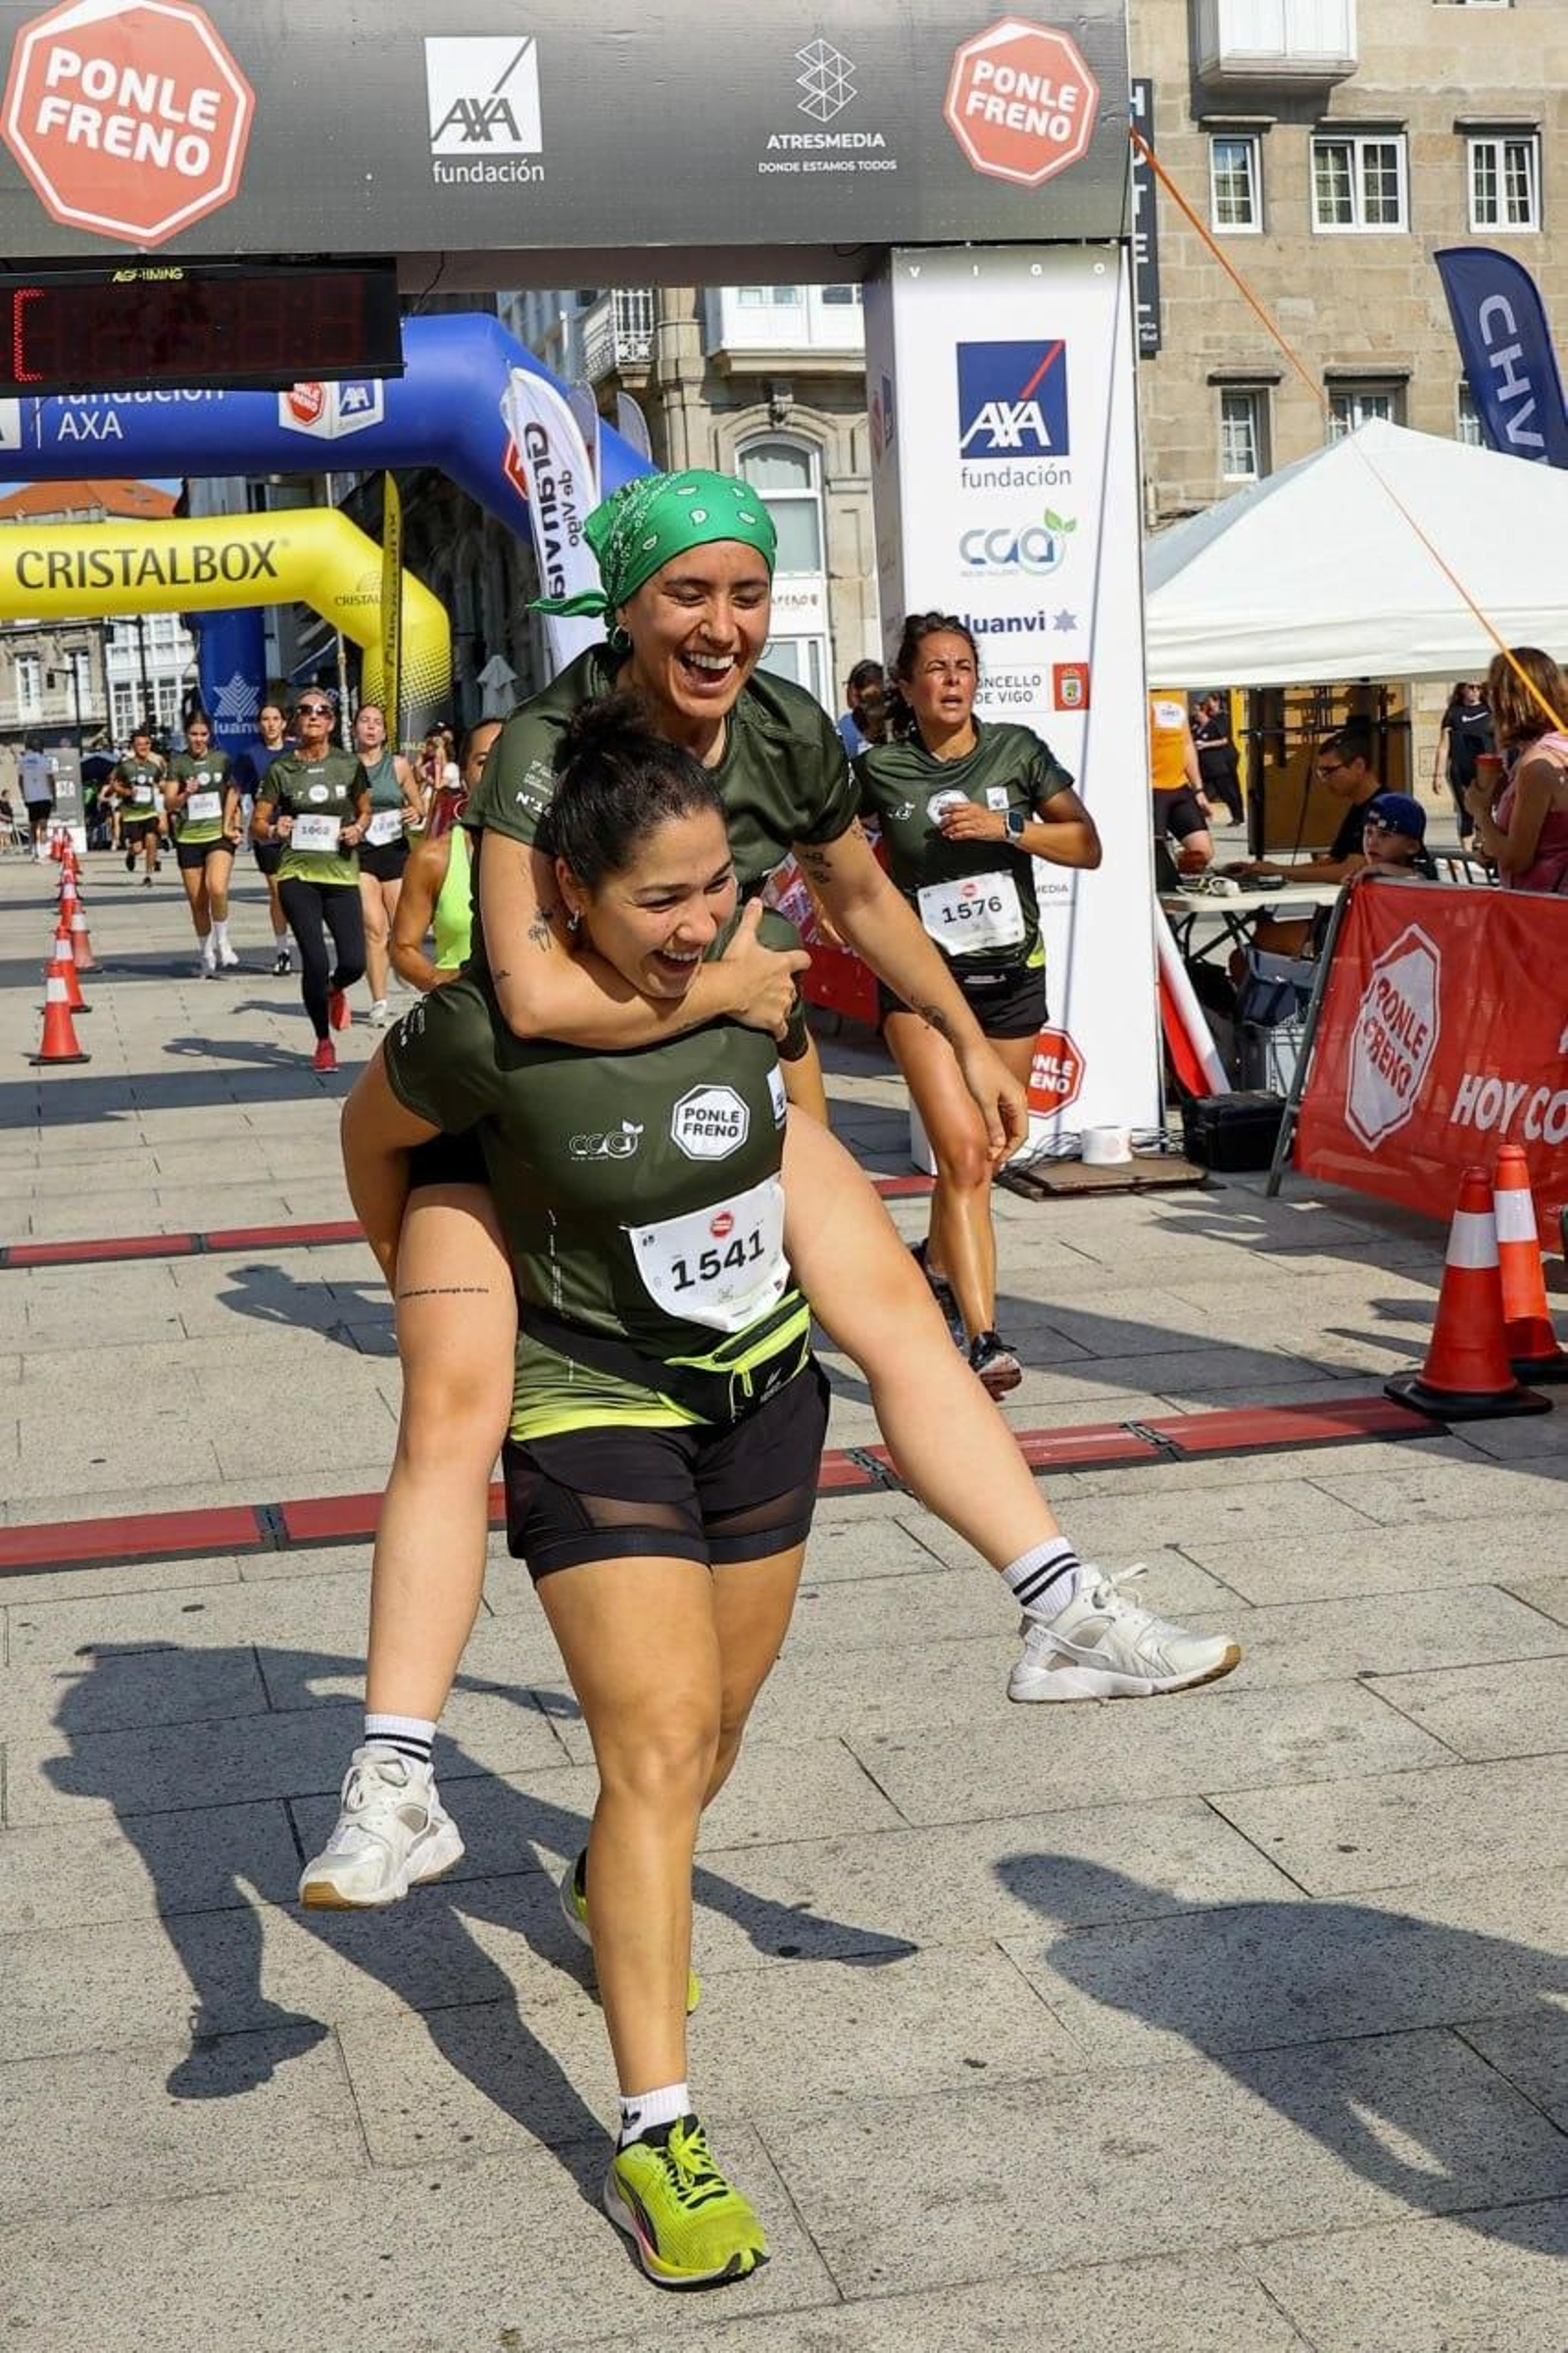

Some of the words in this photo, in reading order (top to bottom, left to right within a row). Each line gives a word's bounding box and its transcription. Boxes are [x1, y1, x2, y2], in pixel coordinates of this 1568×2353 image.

[45, 47, 221, 132] PONLE
[972, 59, 1078, 113] PONLE
[430, 98, 521, 142] AXA
[965, 90, 1072, 142] FRENO
[35, 96, 211, 176] FRENO
[766, 132, 886, 149] ATRESMEDIA
[433, 158, 544, 182] fundación
[759, 162, 800, 172] DONDE
[803, 161, 856, 172] ESTAMOS
[858, 160, 897, 171] TODOS
[1479, 295, 1548, 463] CHV
[57, 411, 122, 441] AXA
[959, 401, 1053, 449] AXA
[961, 463, 1071, 489] fundación
[16, 540, 278, 589] CRISTALBOX
[335, 594, 380, 607] CRISTAL
[978, 675, 1041, 688] ONCELLO
[998, 691, 1033, 704] VIGO
[942, 896, 1003, 924] 1576
[1377, 977, 1428, 1060] PONLE
[1032, 1054, 1075, 1078] NLE
[1029, 1071, 1070, 1095] ENO
[685, 1107, 740, 1123] PONLE
[1450, 1073, 1529, 1135] HOY
[683, 1124, 739, 1138] FRENO
[670, 1229, 765, 1293] 1541
